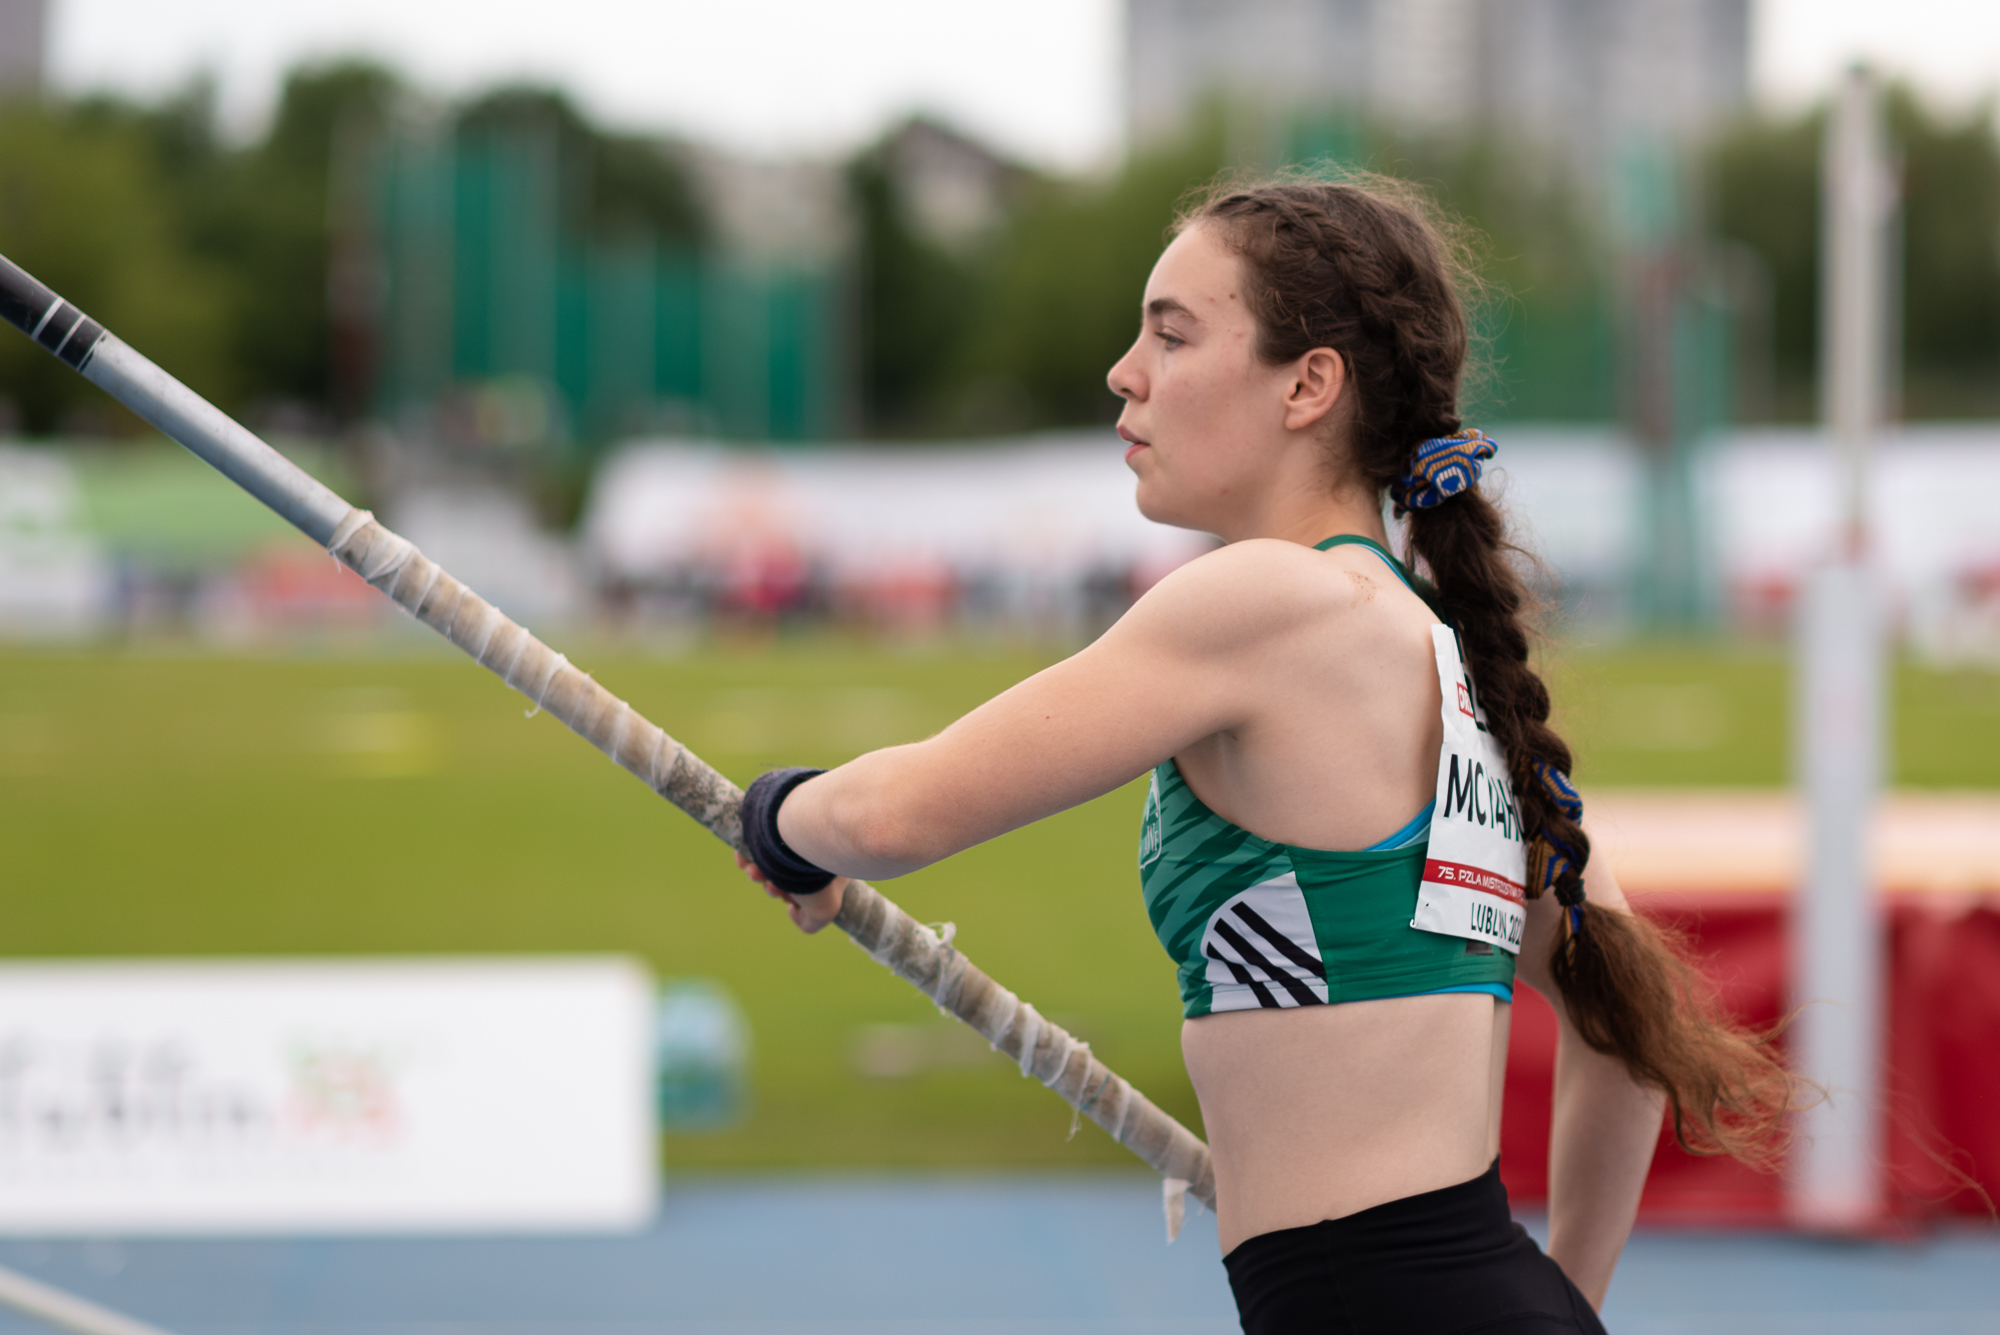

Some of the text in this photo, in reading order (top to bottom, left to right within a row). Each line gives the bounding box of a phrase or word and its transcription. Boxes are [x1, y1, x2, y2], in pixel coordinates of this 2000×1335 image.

[1438, 866, 1457, 880] 75.
[1459, 869, 1482, 885] PZLA
[1471, 902, 1507, 940] LUBLIN
